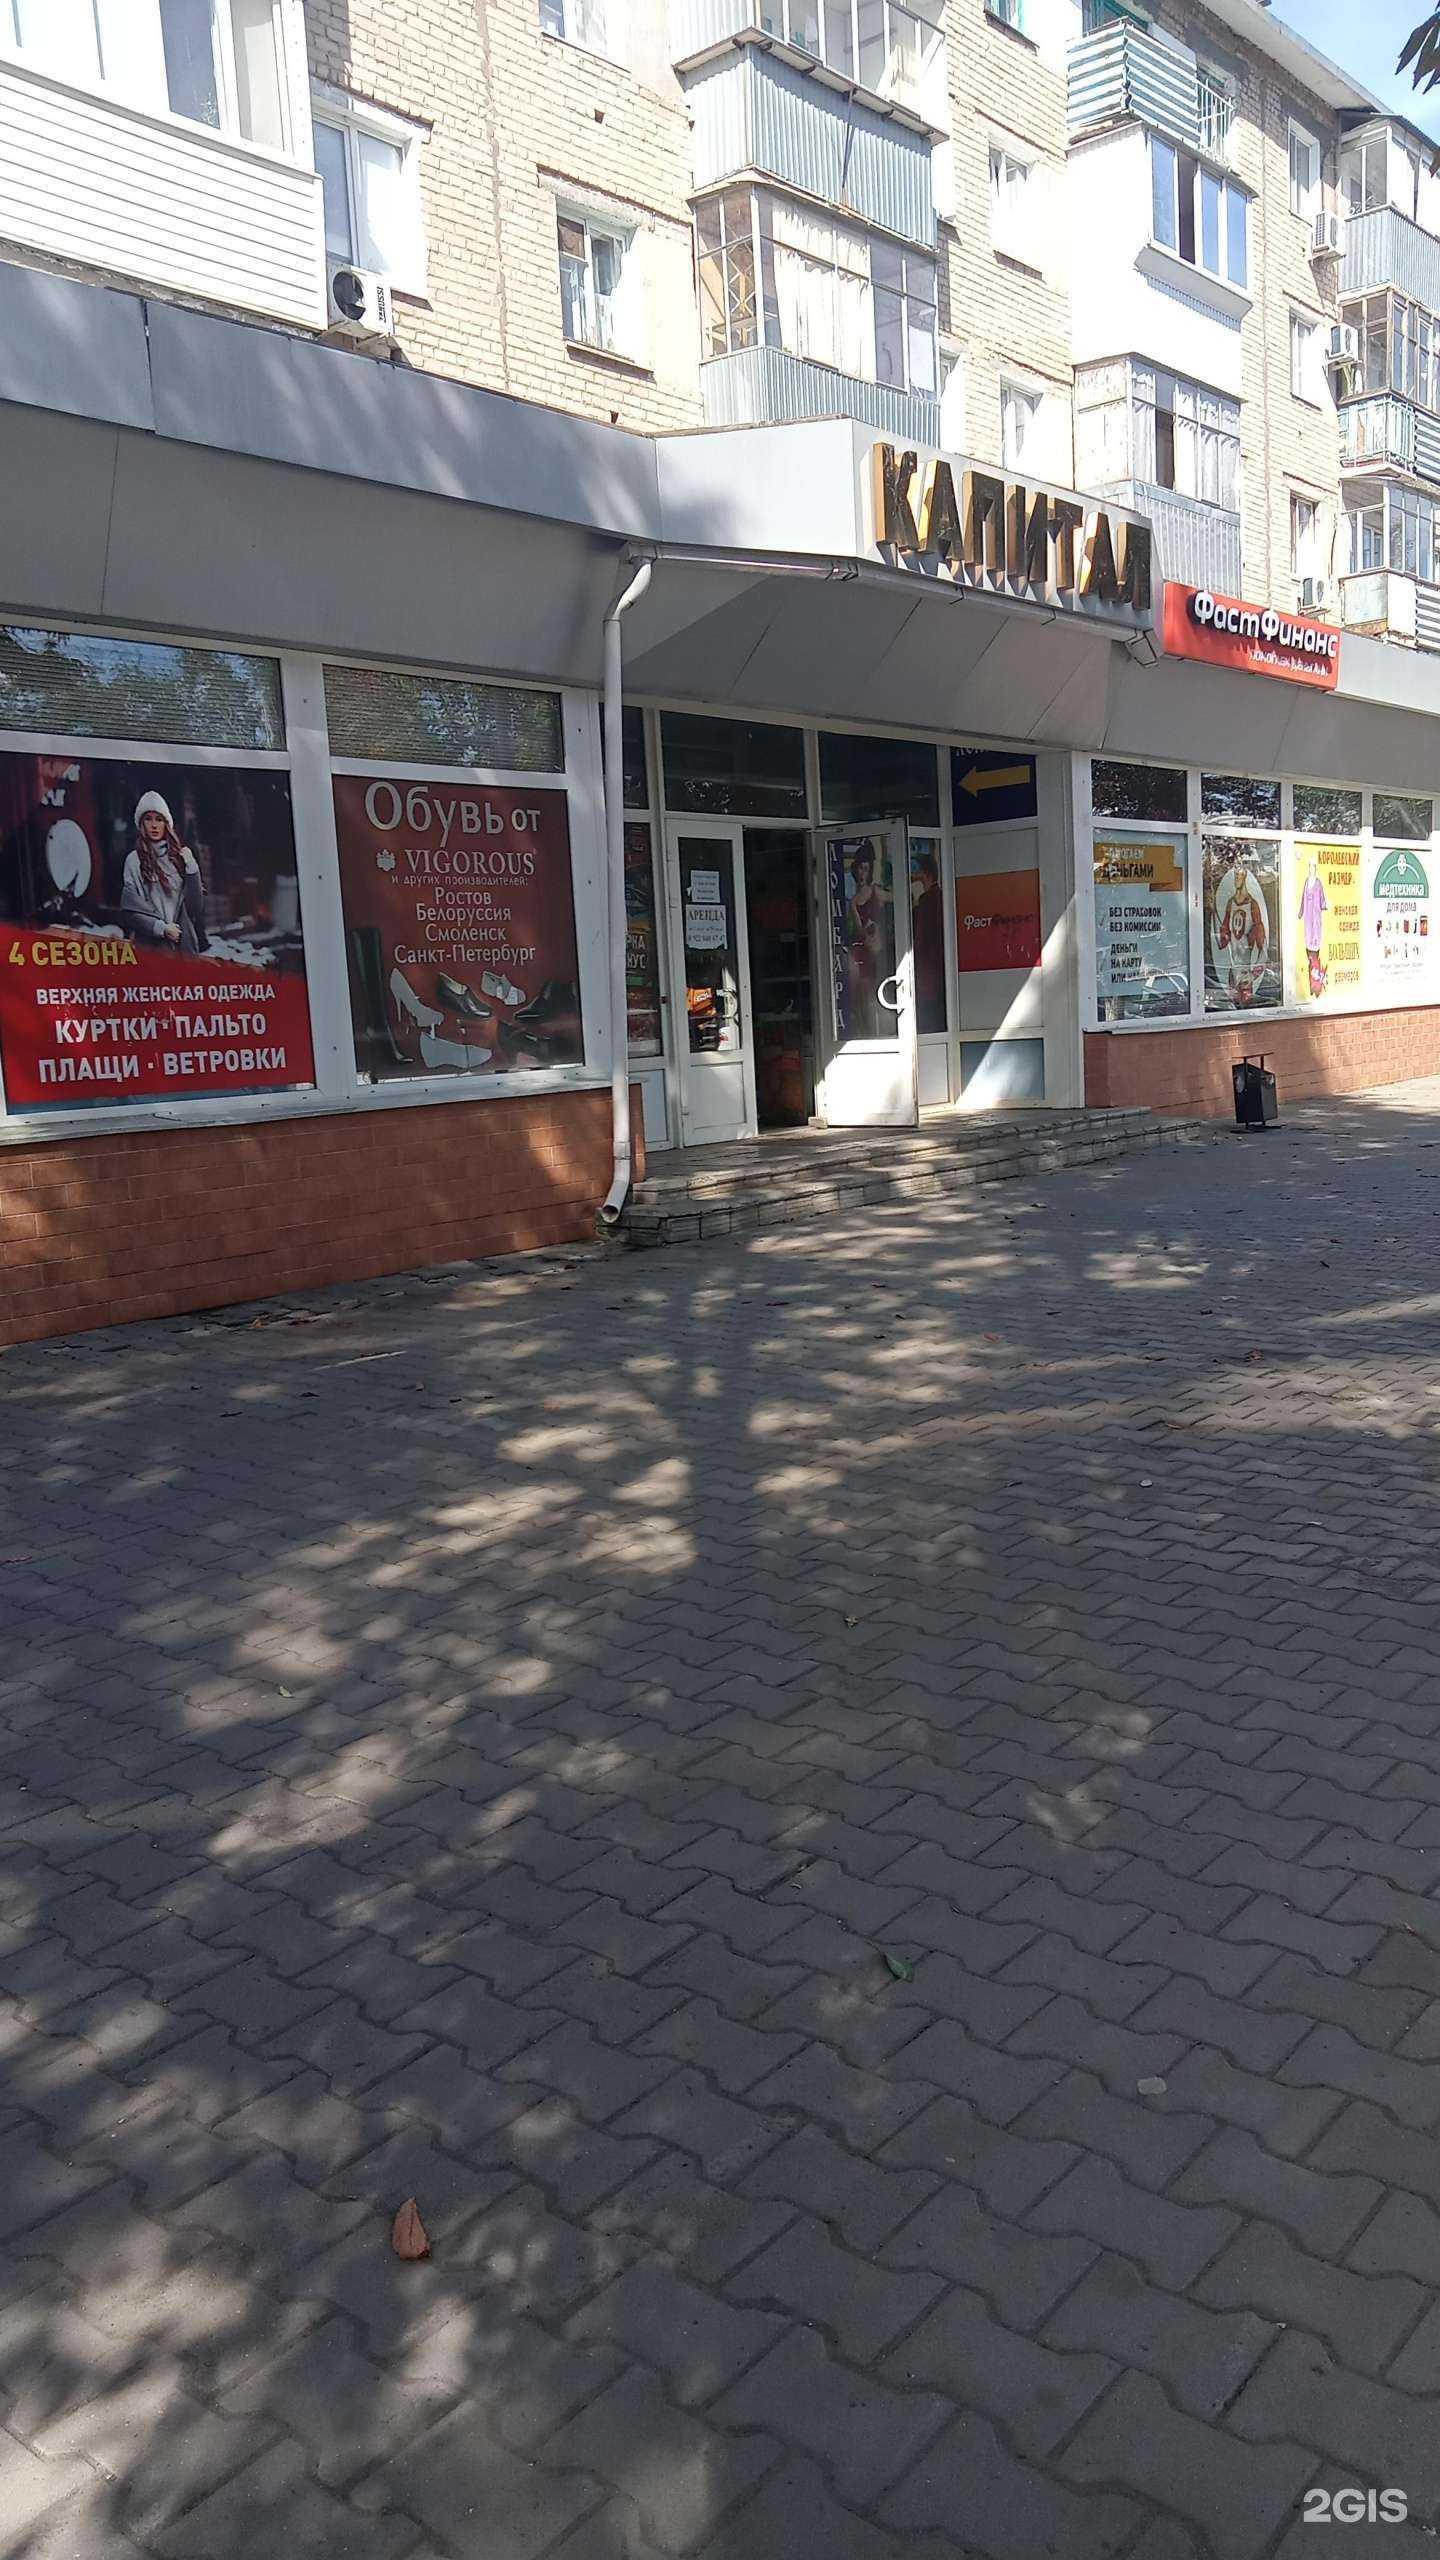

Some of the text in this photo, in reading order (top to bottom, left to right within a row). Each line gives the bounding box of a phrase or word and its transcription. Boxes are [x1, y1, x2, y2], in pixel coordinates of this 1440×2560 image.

[872, 441, 1151, 610] КАПИТАЛ
[1194, 590, 1339, 658] ФастФинанс
[365, 781, 540, 847] Обувь от
[405, 849, 535, 875] VIGOROUS
[404, 874, 440, 888] других
[435, 886, 492, 905] Ростов
[416, 903, 511, 926] Белоруссия
[1109, 906, 1123, 918] БЕЗ
[425, 923, 507, 942] Смоленск
[1109, 921, 1162, 932] БЕЗ КОМИССИИ
[8, 942, 138, 966] 4 СЕЗОНА
[394, 944, 536, 966] Санкт-Петербург
[1111, 943, 1138, 956] ДЕНЬГИ
[1111, 957, 1143, 969] НА КАРТУ
[36, 984, 276, 1005] ВЕРХНЯЯ ЖЕНСКАЯ ОДЕЖДА
[55, 1013, 267, 1044] КУРТКИ ПАЛЬТО
[38, 1047, 287, 1083] ПЛАЩИ ВЕТРОВКИ
